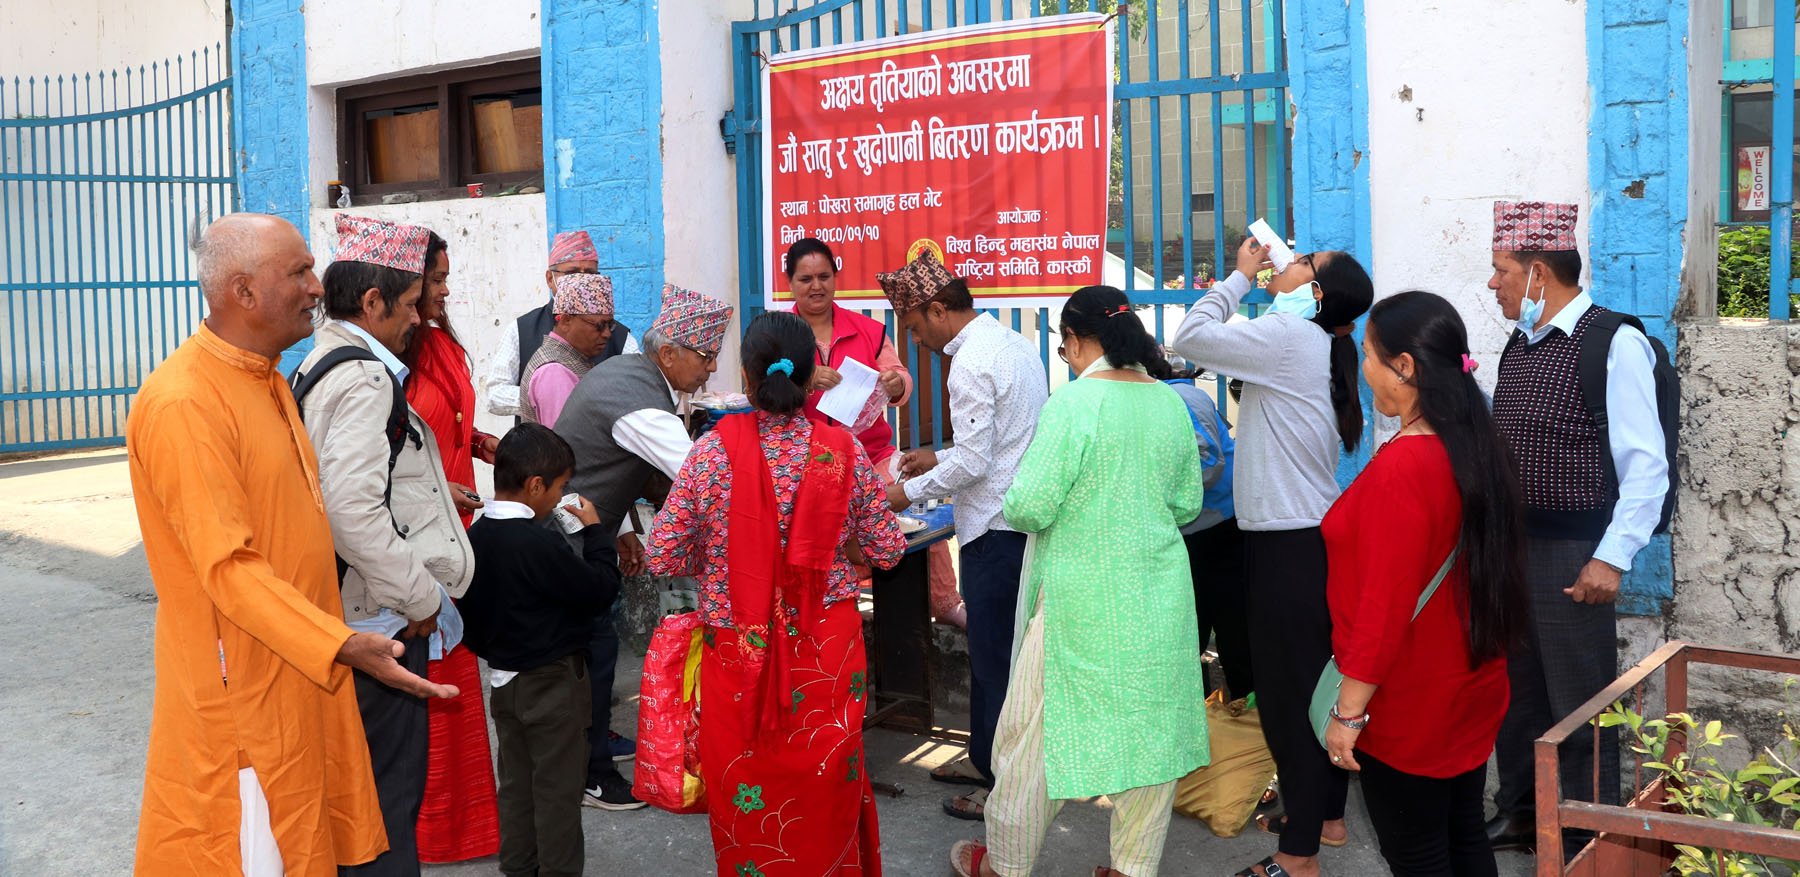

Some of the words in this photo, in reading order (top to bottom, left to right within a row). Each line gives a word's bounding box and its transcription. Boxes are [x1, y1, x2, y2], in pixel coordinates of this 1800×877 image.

[820, 74, 865, 111] अक्षय
[868, 54, 941, 113] तृतियाको
[946, 53, 1032, 95] अवसरमा
[801, 138, 833, 179] सातु
[836, 137, 849, 170] र
[852, 119, 924, 177] खुदोपानी
[928, 116, 989, 161] बितरण
[994, 108, 1085, 155] कार्यक्रम
[1753, 151, 1764, 207] WELCOME
[780, 200, 808, 218] स्थान
[818, 194, 851, 215] पोखरा
[853, 193, 896, 216] सभागृह
[898, 192, 920, 211] हल
[923, 187, 943, 208] गेट
[996, 206, 1041, 225] आयोजक
[945, 235, 972, 255] विश्व
[974, 234, 1007, 257] हिन्दु
[1009, 234, 1058, 253] महासंघ
[1061, 231, 1101, 250] नेपाल
[954, 258, 995, 281] राष्ट्रिय
[1046, 255, 1092, 276] कास्की
